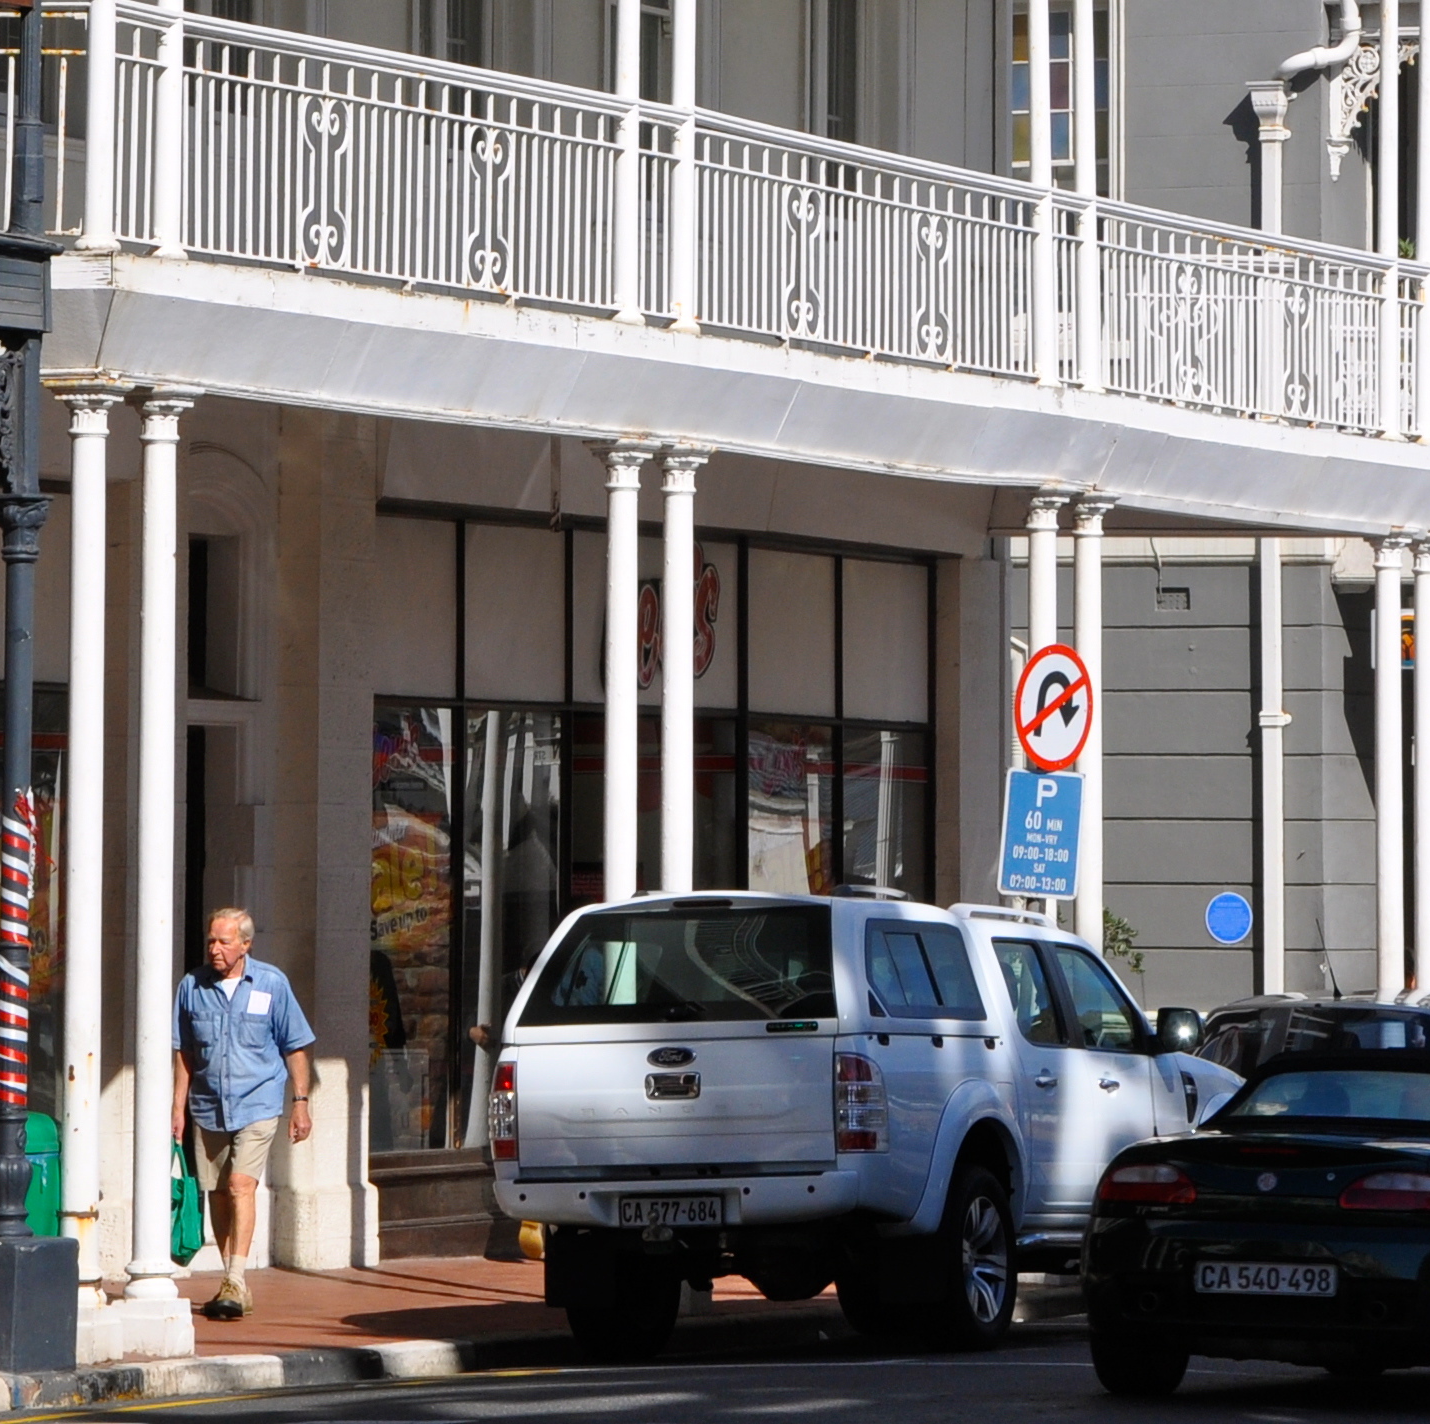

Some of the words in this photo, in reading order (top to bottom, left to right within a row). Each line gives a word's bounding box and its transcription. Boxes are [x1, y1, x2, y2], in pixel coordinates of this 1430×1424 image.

[1036, 778, 1058, 808] P
[1025, 811, 1042, 829] 60
[1012, 845, 1069, 863] 09:00-18:00
[1033, 864, 1046, 874] SAT
[622, 1204, 643, 1224] CA
[1201, 1265, 1231, 1289] CA
